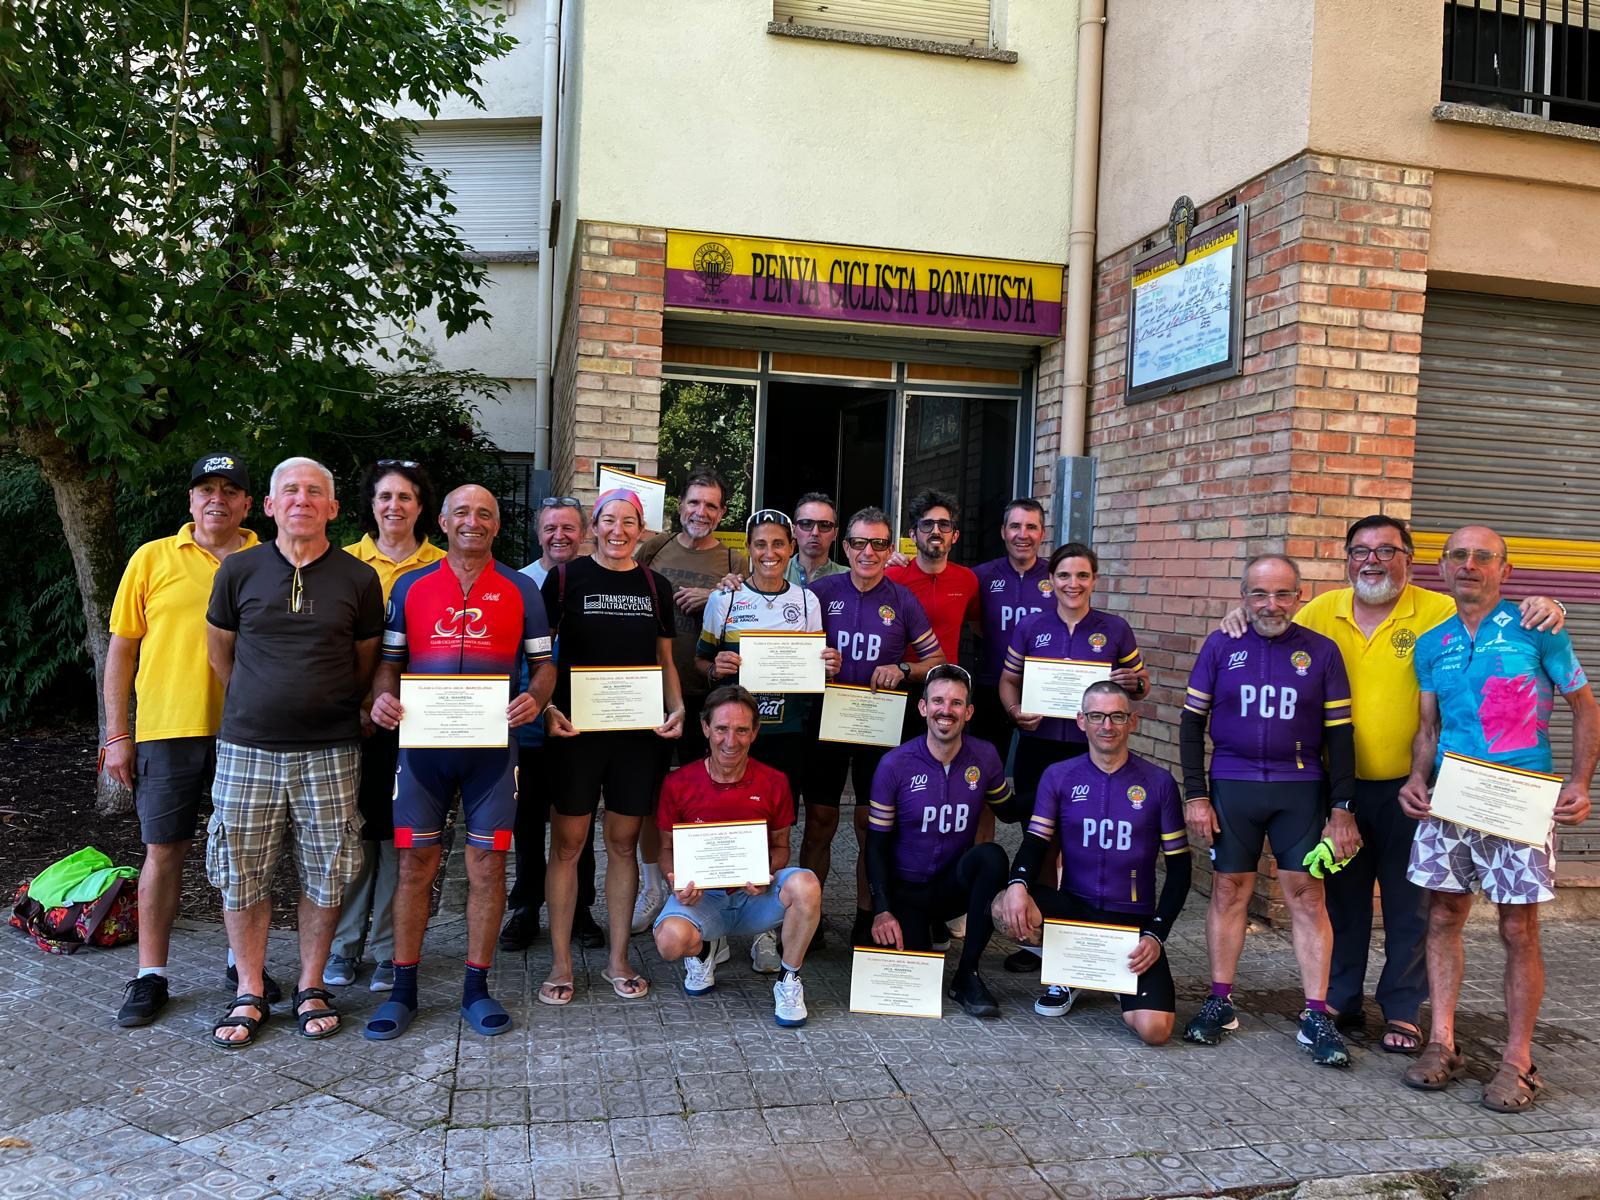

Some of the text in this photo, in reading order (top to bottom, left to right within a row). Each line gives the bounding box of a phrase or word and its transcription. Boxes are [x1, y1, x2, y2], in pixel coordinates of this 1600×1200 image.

[750, 253, 1036, 323] PENYA CICLISTA BONAVISTA
[991, 579, 1006, 588] 100
[601, 602, 653, 612] ULTRACYCLING
[828, 600, 845, 612] 100
[837, 630, 882, 662] PCB
[1036, 632, 1052, 646] 100
[1228, 650, 1248, 666] 100
[1240, 684, 1298, 720] PCB
[910, 774, 928, 789] 100
[1071, 784, 1089, 798] 100
[921, 803, 970, 834] PCB
[1082, 817, 1133, 851] PCB
